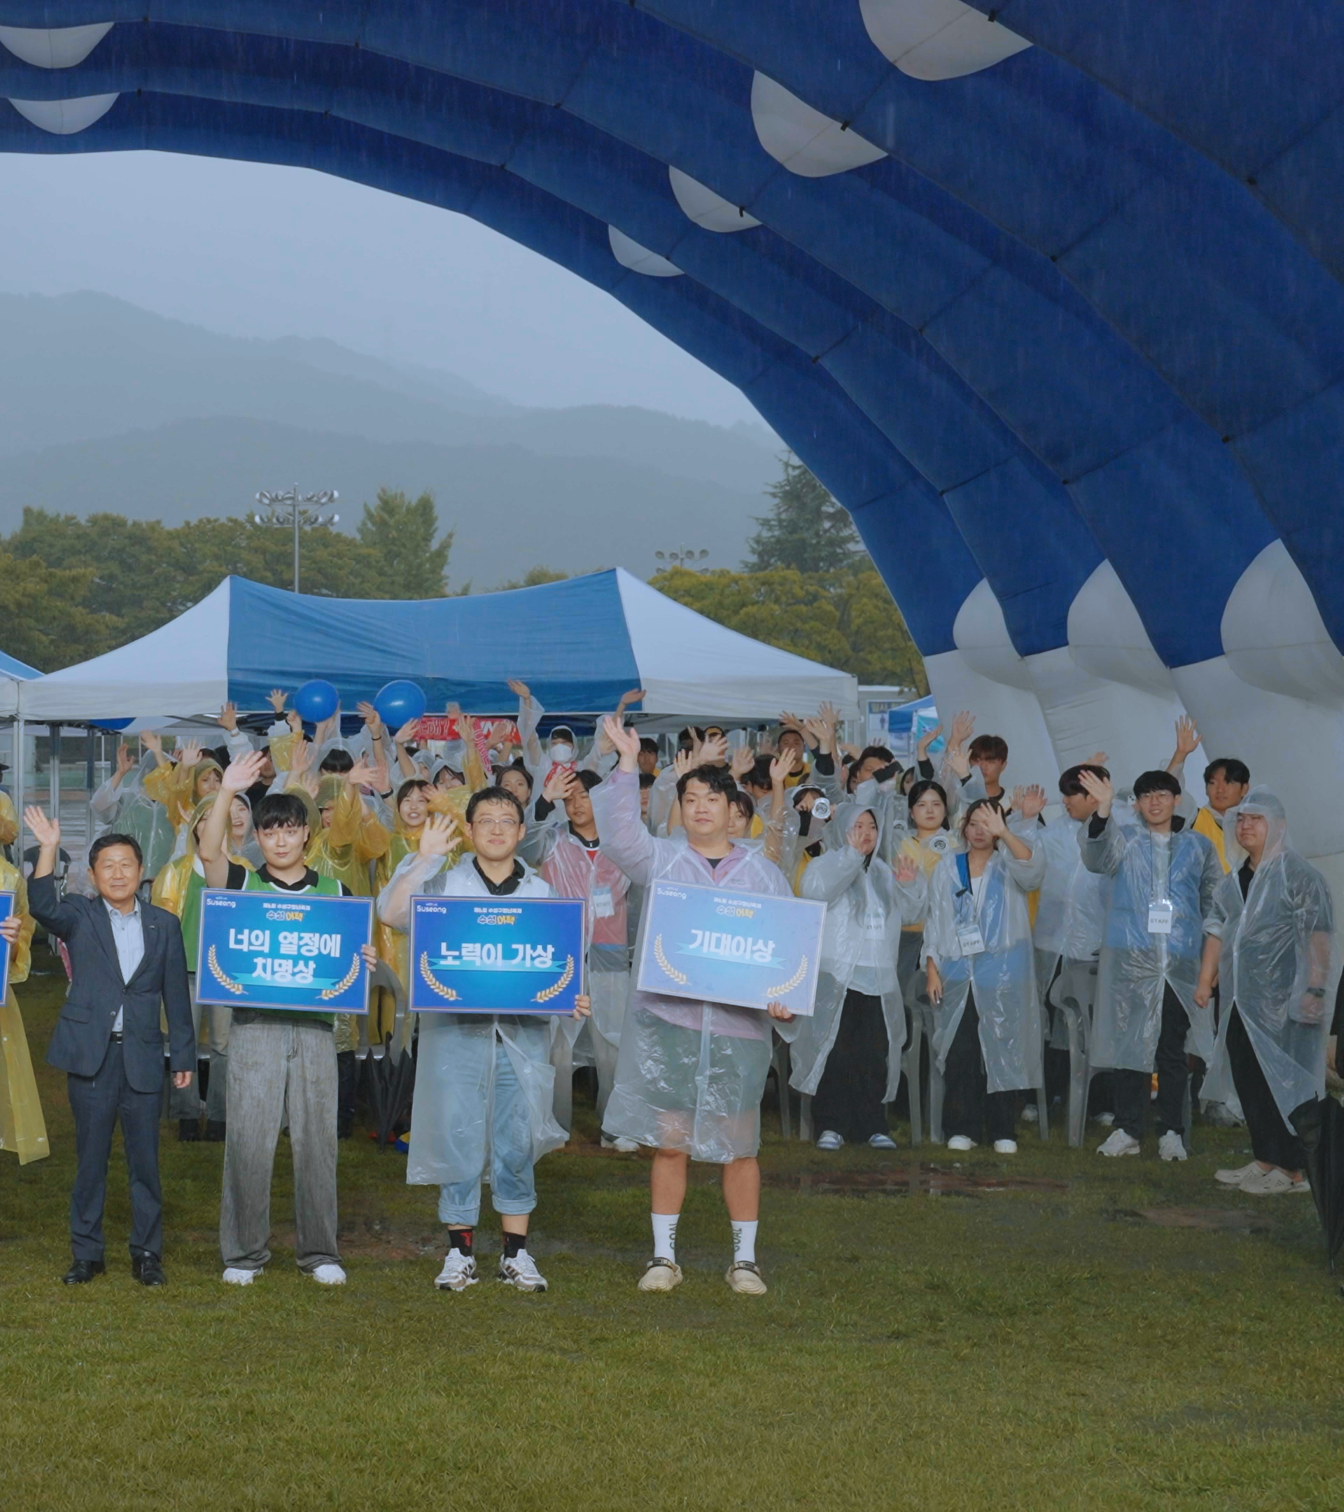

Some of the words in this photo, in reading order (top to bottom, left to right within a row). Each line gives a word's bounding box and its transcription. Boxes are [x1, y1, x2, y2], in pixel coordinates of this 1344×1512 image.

[657, 887, 687, 899] Suseong
[206, 898, 236, 908] Suseong
[416, 905, 447, 914] Suseong
[229, 928, 270, 953] 너의
[278, 931, 341, 957] 열정에
[688, 928, 776, 963] 기대이상
[962, 939, 980, 948] STAFF
[439, 942, 503, 967] 노력이
[511, 944, 555, 968] 가상
[252, 957, 316, 984] 치명상
